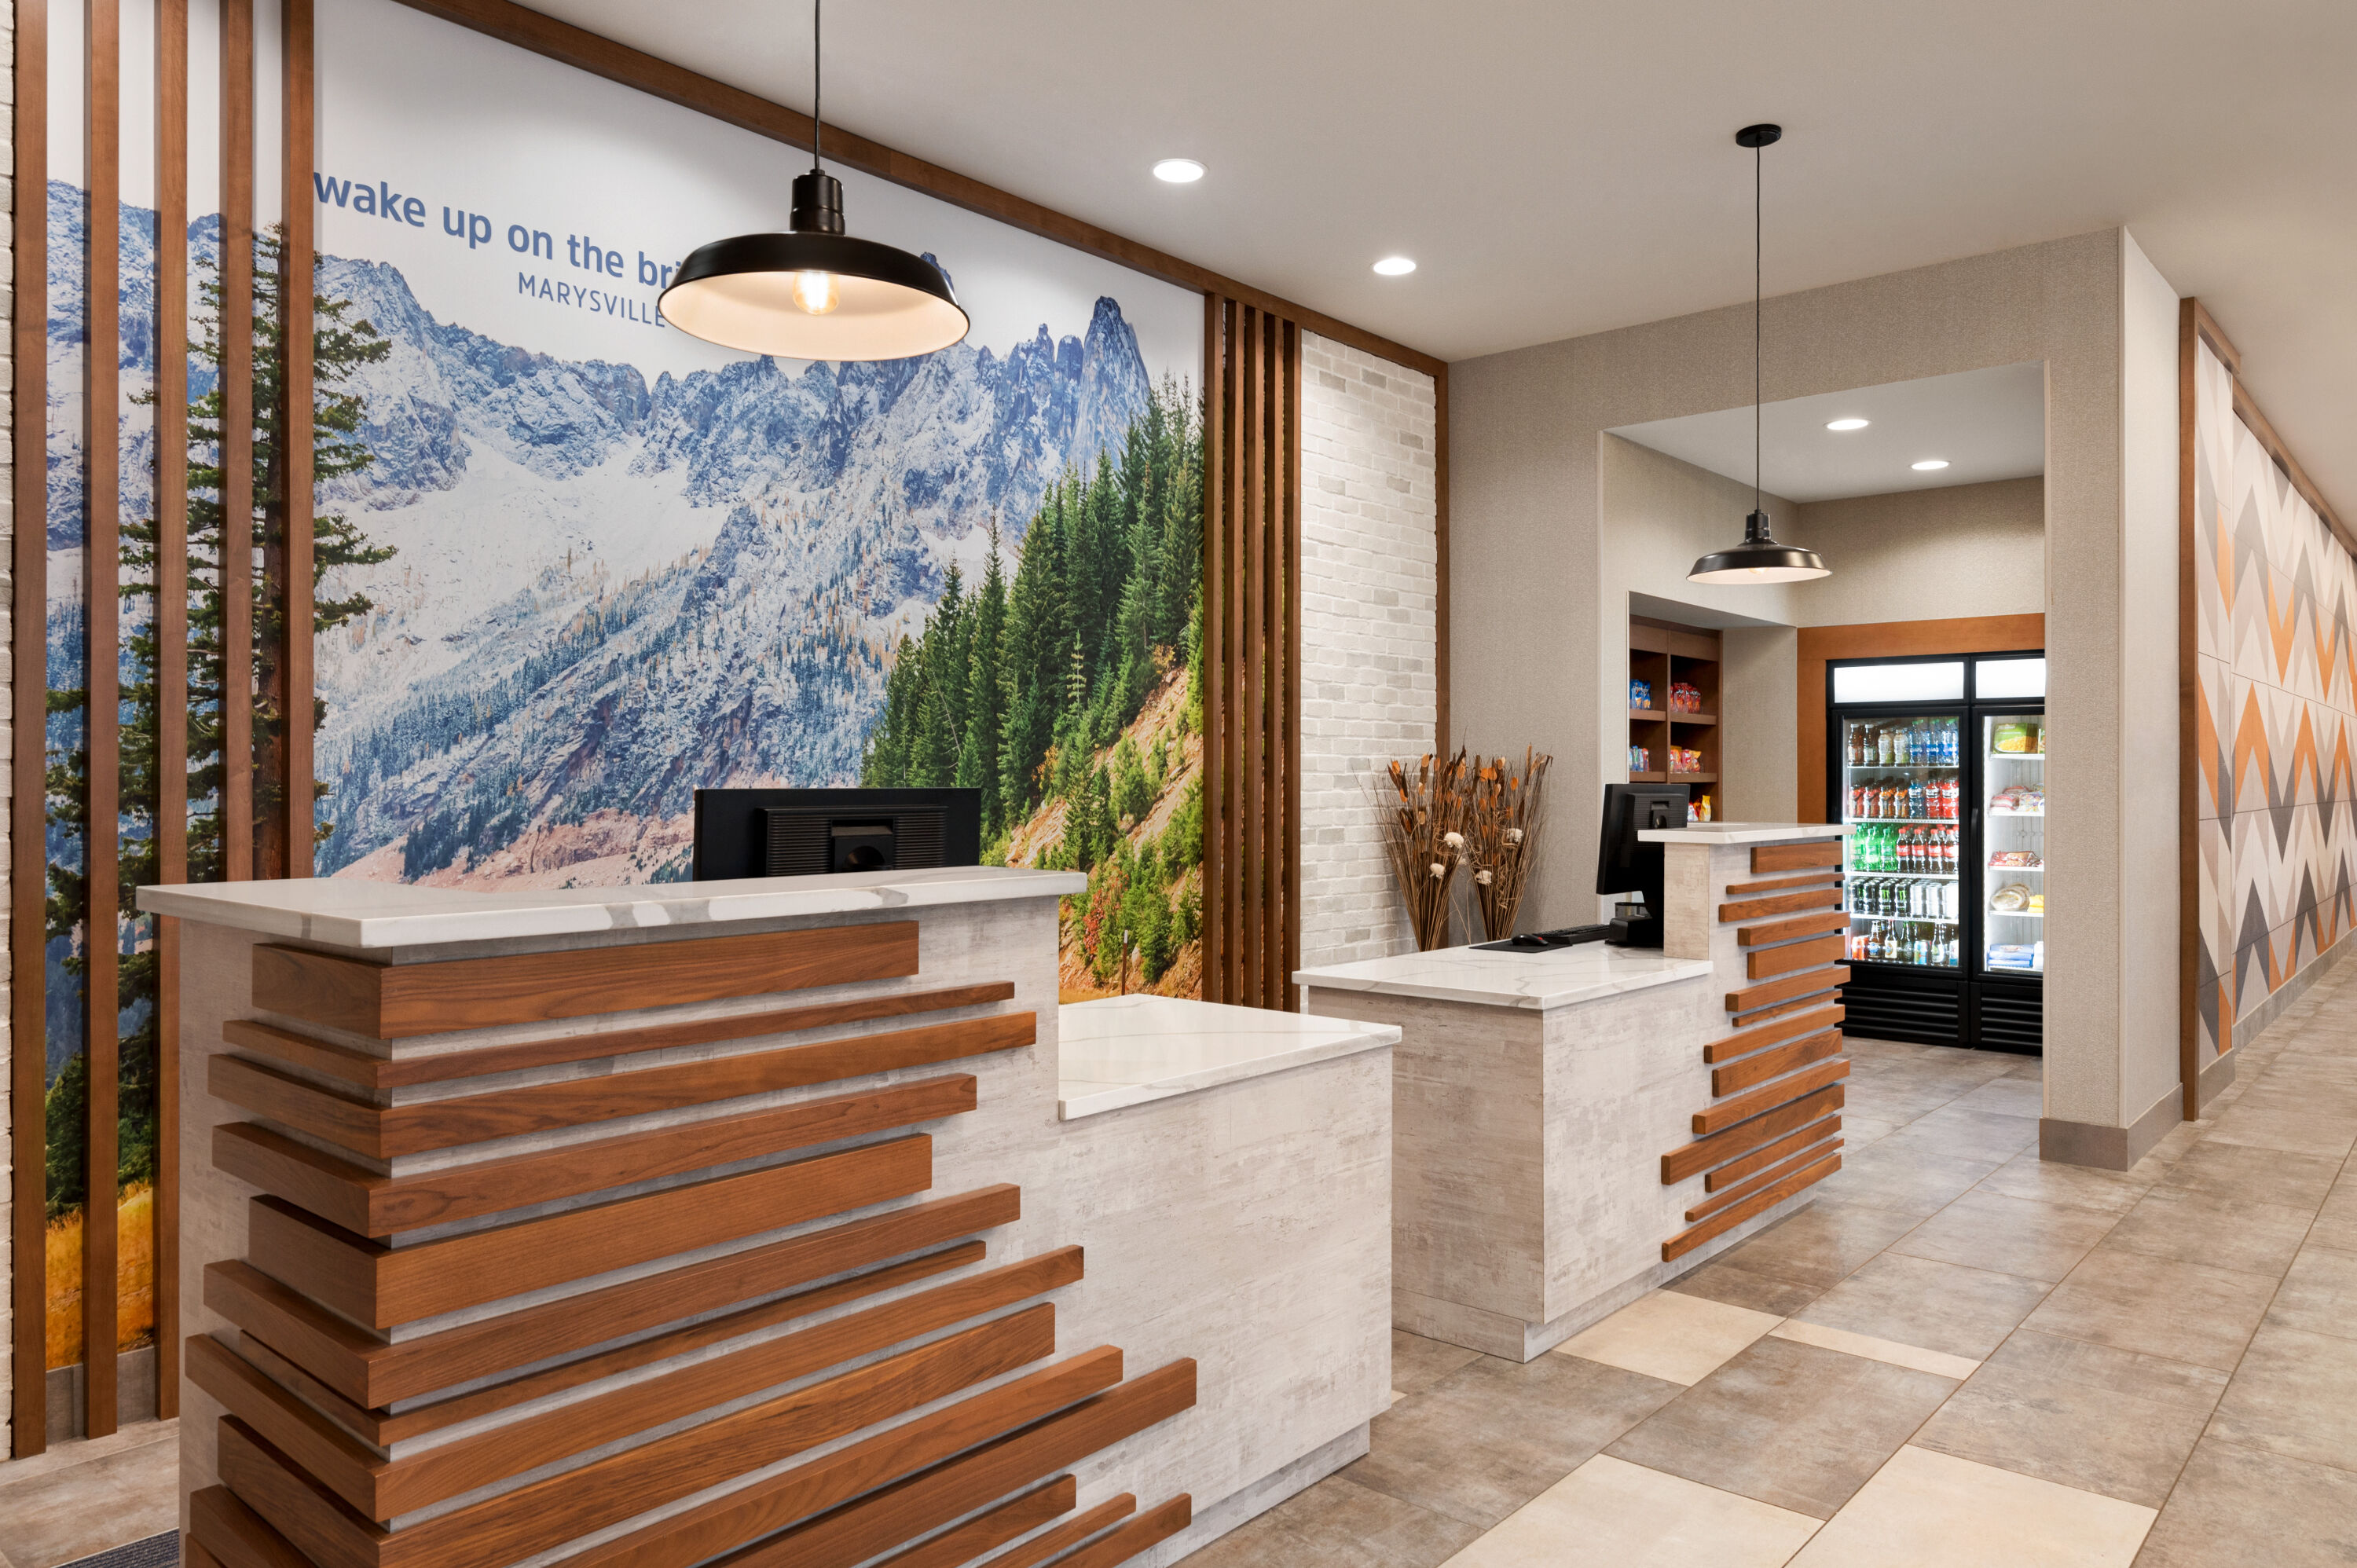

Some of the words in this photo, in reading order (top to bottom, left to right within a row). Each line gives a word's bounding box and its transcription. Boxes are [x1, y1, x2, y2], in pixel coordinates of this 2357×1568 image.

[313, 171, 426, 228] wake
[443, 206, 493, 249] up
[508, 225, 553, 261] on
[566, 233, 625, 278] the
[518, 271, 665, 328] MARYSVILLE
